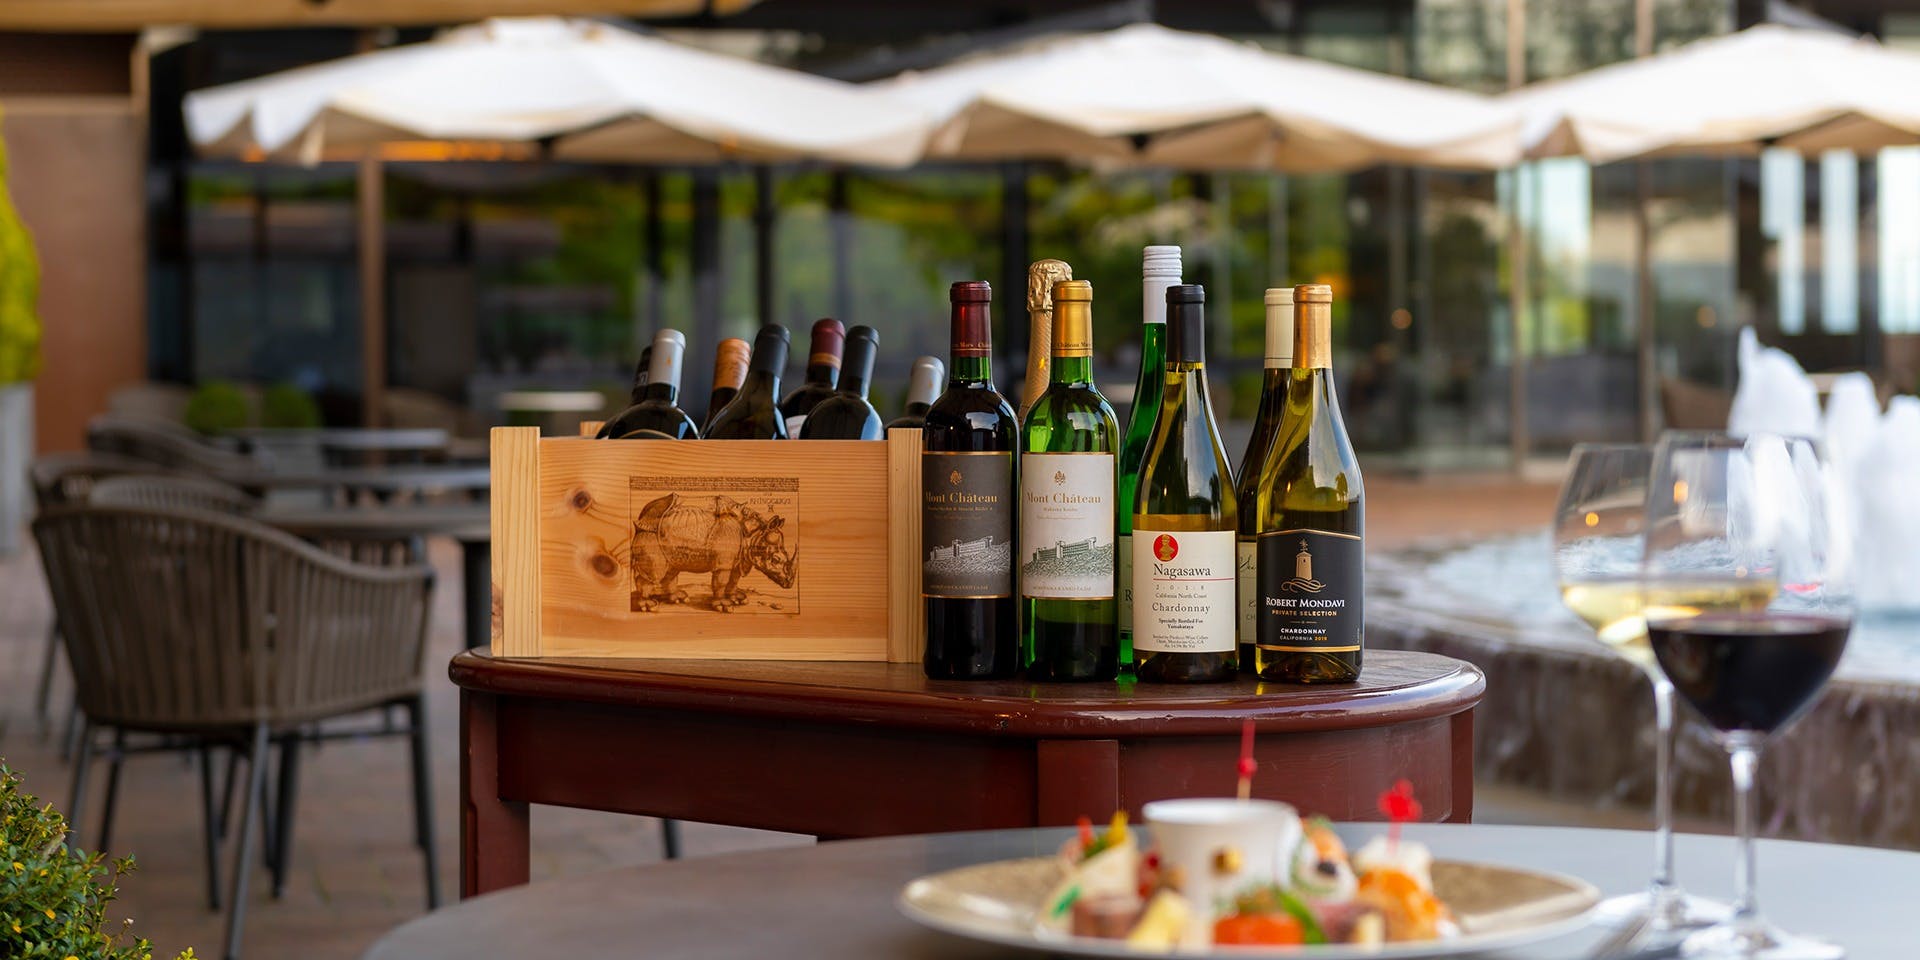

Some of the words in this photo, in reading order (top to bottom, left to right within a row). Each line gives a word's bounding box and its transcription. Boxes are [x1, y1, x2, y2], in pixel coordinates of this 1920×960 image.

[949, 491, 998, 503] Château
[1026, 492, 1049, 504] Mont
[1053, 492, 1101, 504] Château
[1153, 563, 1212, 580] Nagasawa
[1152, 602, 1211, 615] Chardonnay
[1266, 597, 1298, 608] ROBERT
[1299, 598, 1345, 608] MONDAVI
[1271, 608, 1297, 617] PRIVATE
[1299, 609, 1338, 617] SELECTION
[1280, 627, 1327, 635] CHARDONNAY
